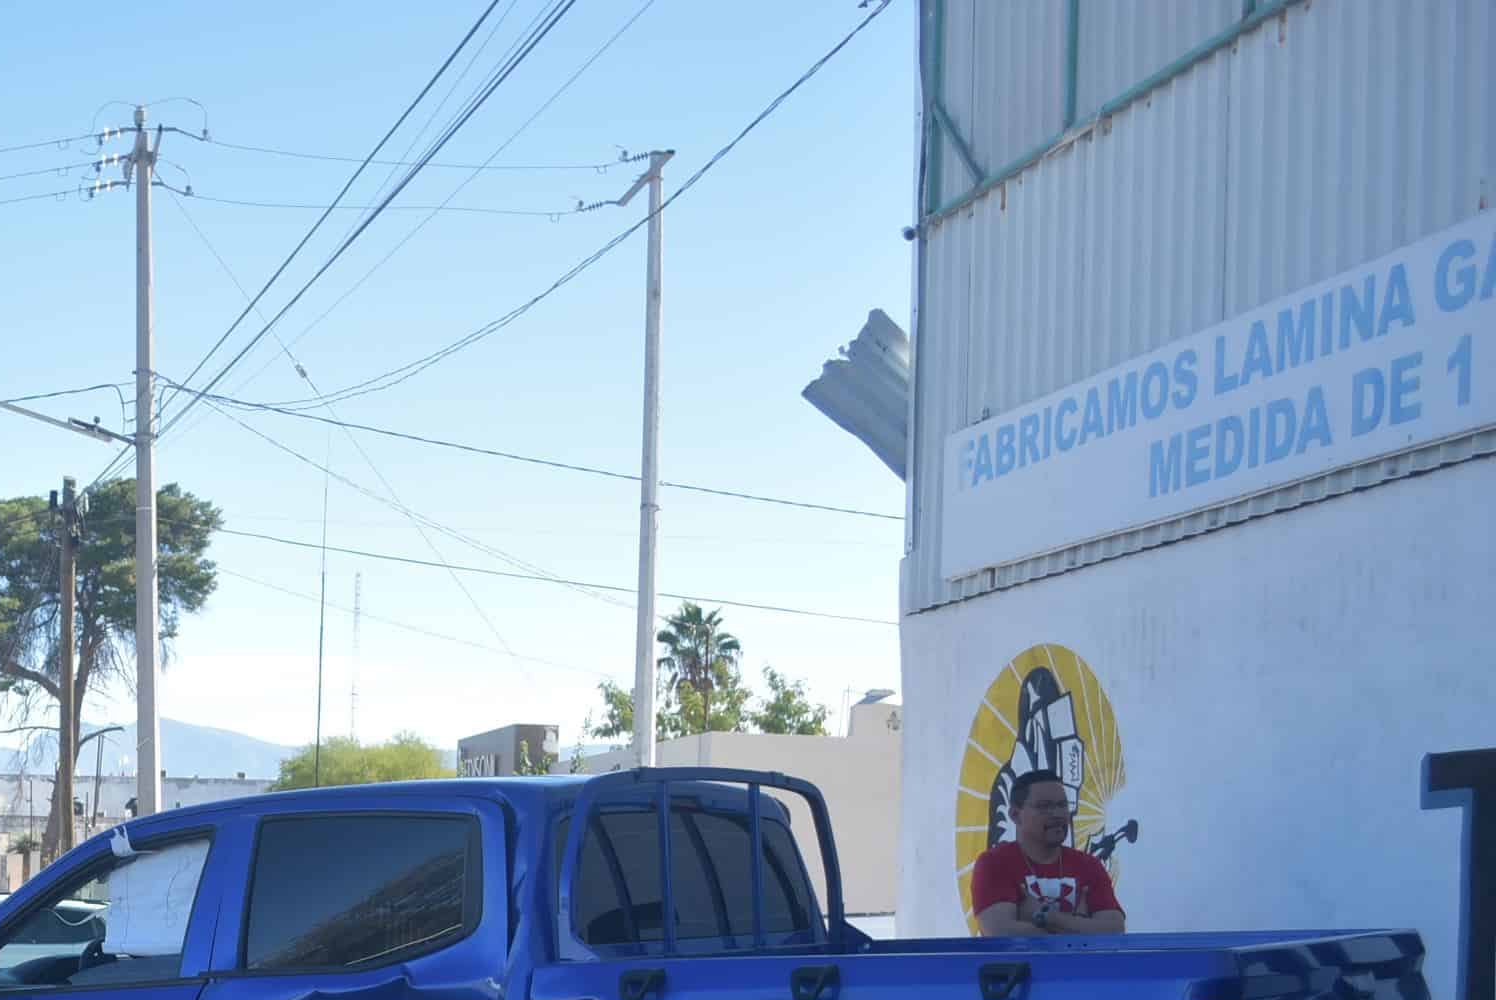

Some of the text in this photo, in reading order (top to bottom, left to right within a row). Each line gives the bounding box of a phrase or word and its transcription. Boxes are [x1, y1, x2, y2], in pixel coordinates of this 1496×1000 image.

[959, 348, 1198, 494] FABRICAMOS
[1213, 261, 1416, 396] LAMINA
[1148, 333, 1472, 499] MEDIDA DE 1
